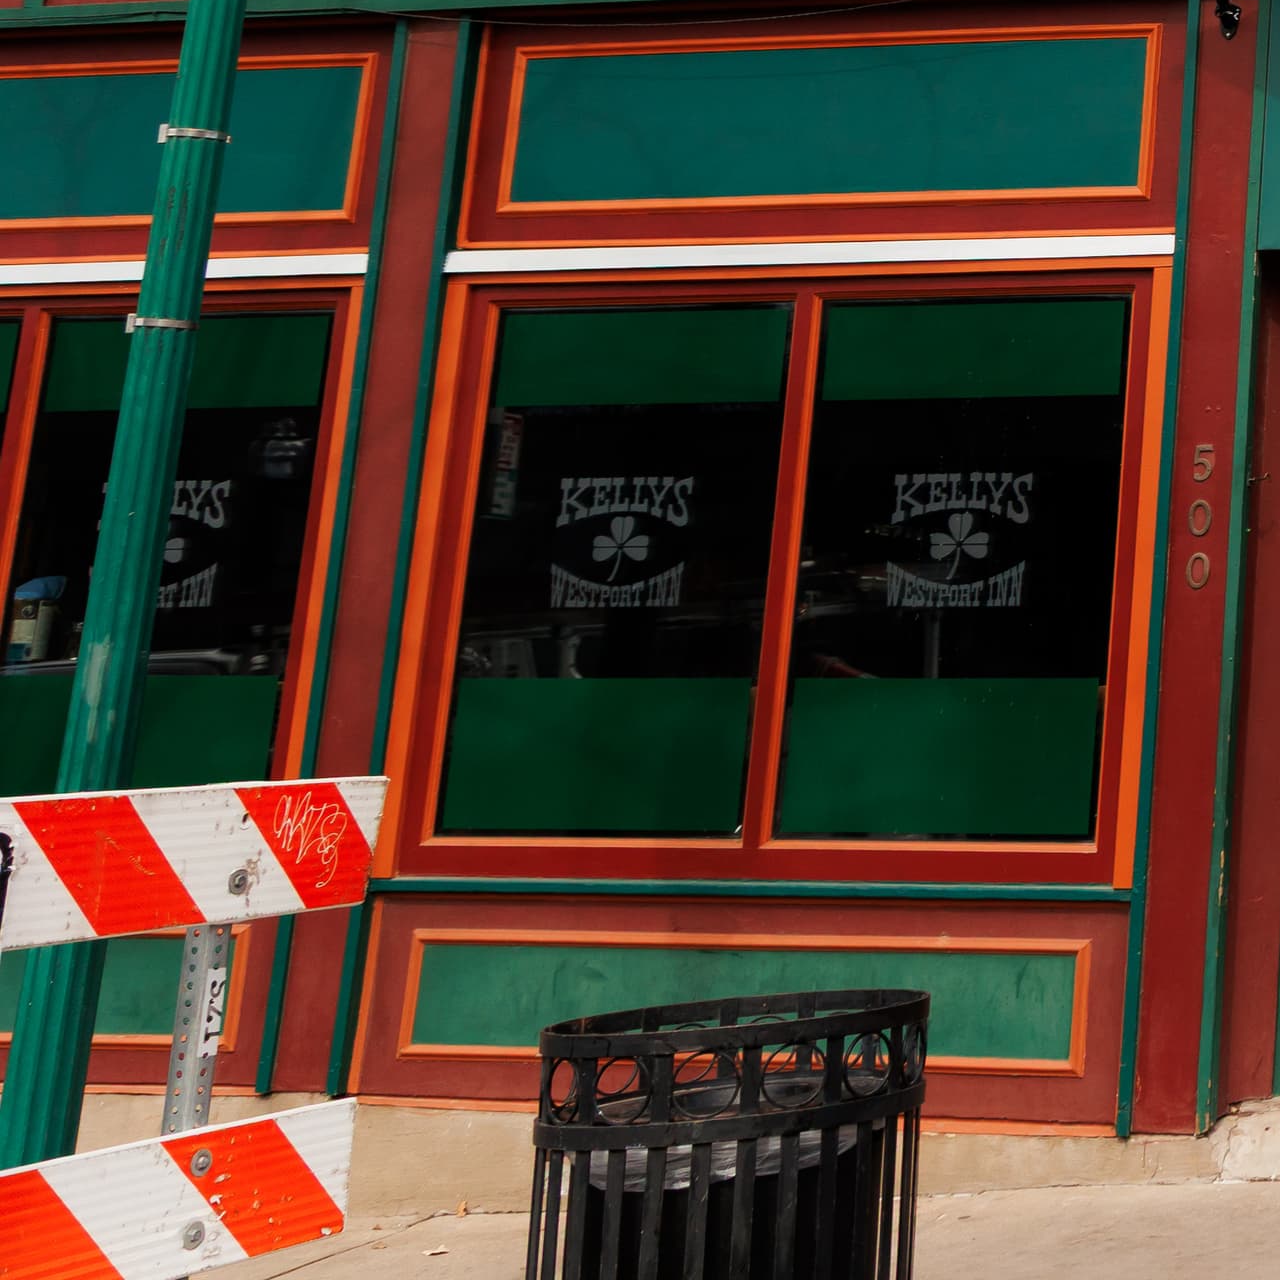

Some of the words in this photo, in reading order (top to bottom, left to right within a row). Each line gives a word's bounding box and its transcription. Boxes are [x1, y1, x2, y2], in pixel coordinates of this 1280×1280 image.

[556, 476, 694, 529] KELLYS
[891, 471, 1034, 525] KELLYS
[1185, 442, 1215, 589] 500
[179, 562, 218, 608] INN
[550, 563, 645, 609] WESTPORT
[646, 561, 685, 607] INN
[885, 560, 986, 608] WESTPORT
[986, 559, 1026, 608] INN
